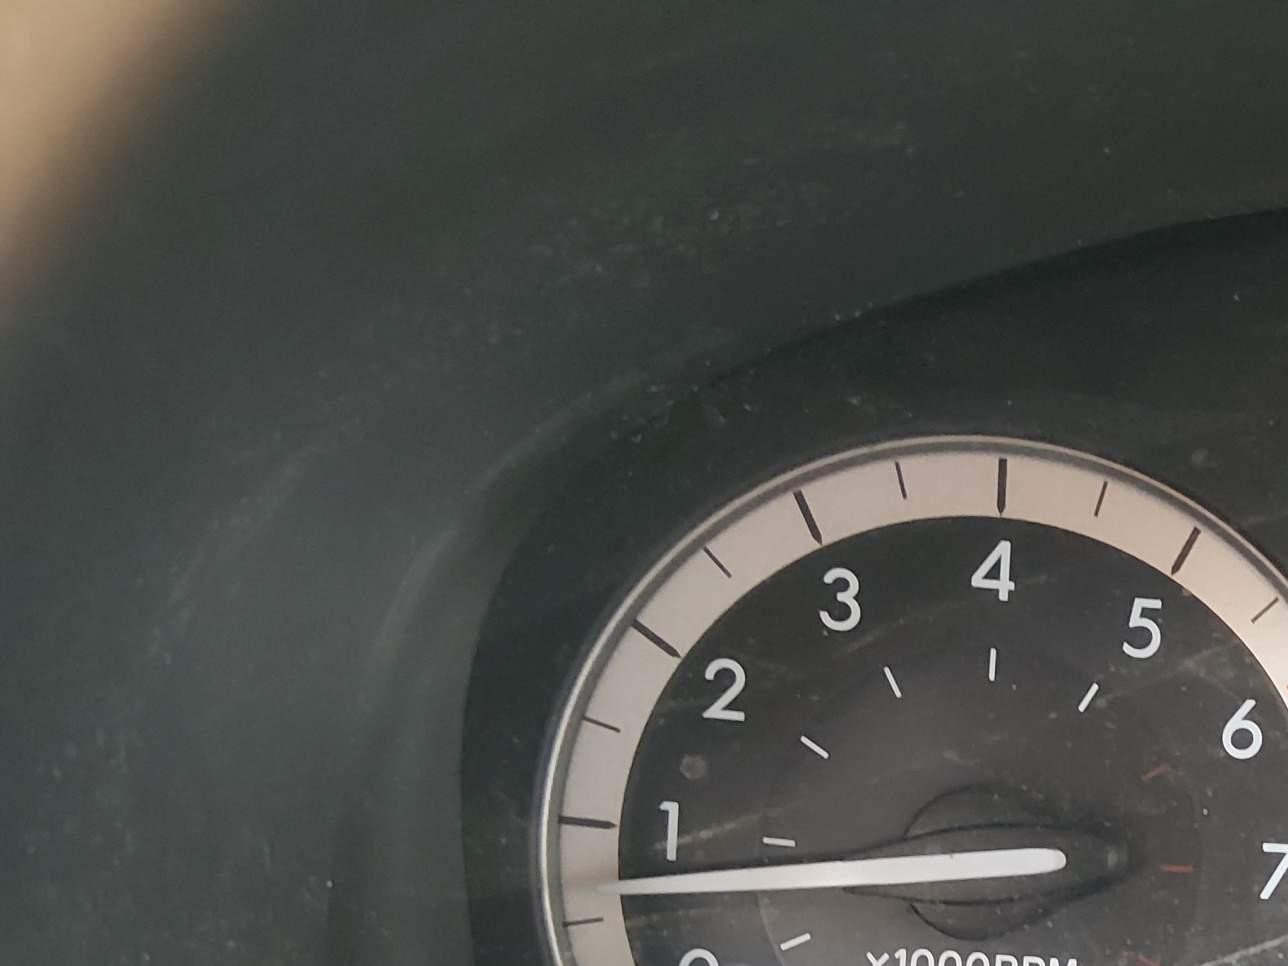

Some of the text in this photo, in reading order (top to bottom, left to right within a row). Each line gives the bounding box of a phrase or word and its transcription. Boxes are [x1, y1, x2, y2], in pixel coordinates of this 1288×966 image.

[818, 567, 862, 632] 3
[971, 540, 1015, 602] 4
[1121, 598, 1163, 659] 5
[702, 659, 747, 722] 2
[1222, 698, 1264, 760] 6
[658, 801, 678, 861] 1
